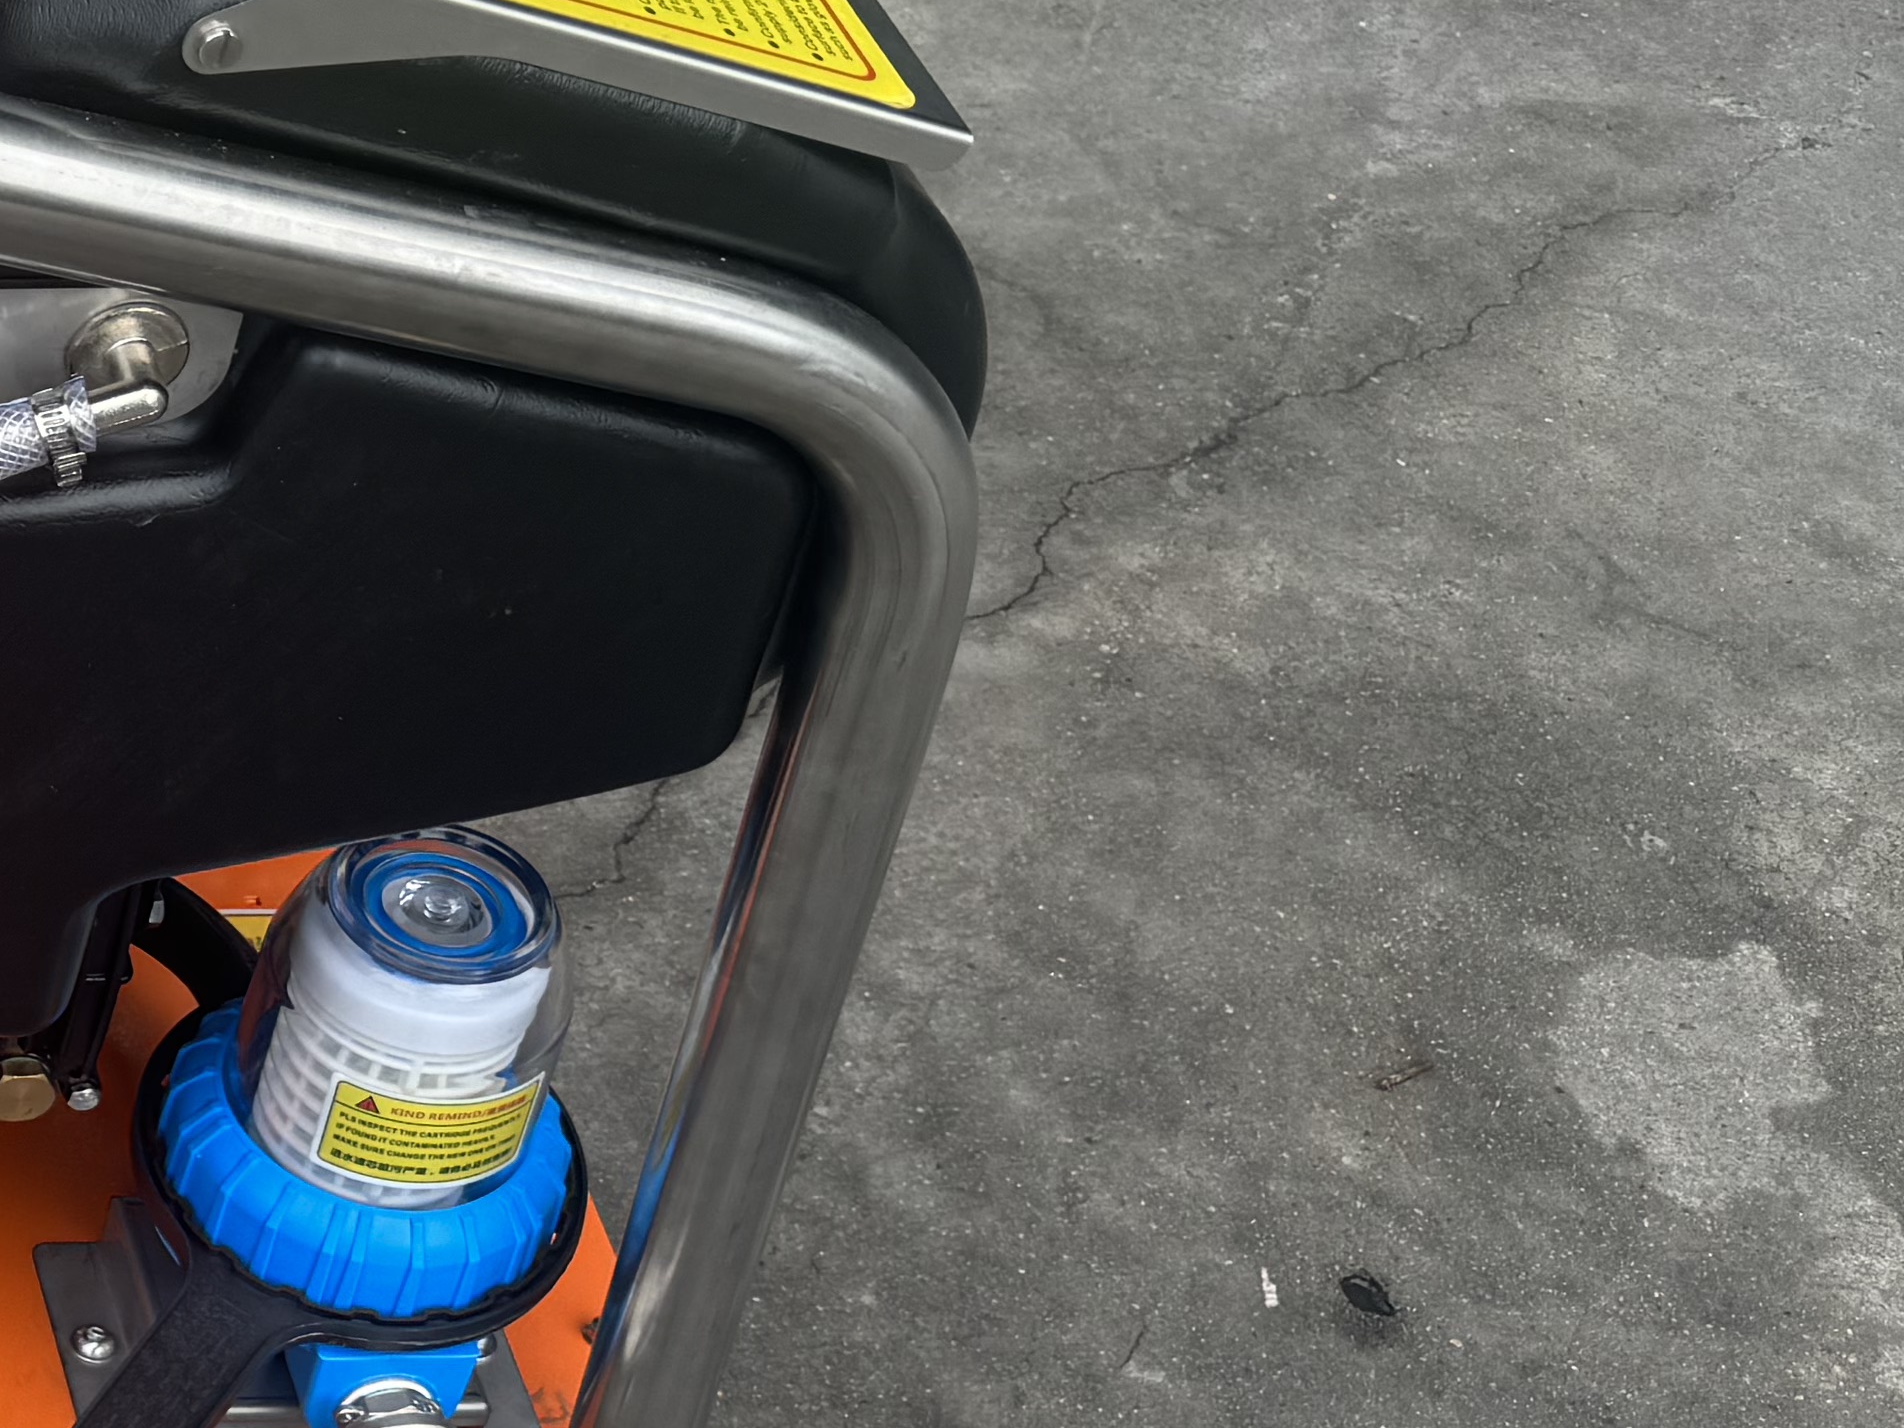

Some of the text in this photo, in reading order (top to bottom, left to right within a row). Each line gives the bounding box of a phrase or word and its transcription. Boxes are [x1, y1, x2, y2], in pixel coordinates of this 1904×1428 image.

[391, 1107, 426, 1120] KIND
[344, 1123, 378, 1142] FOUND
[332, 1133, 359, 1149] MAKE
[360, 1142, 386, 1156] SURE
[386, 1148, 427, 1160] CHANGE
